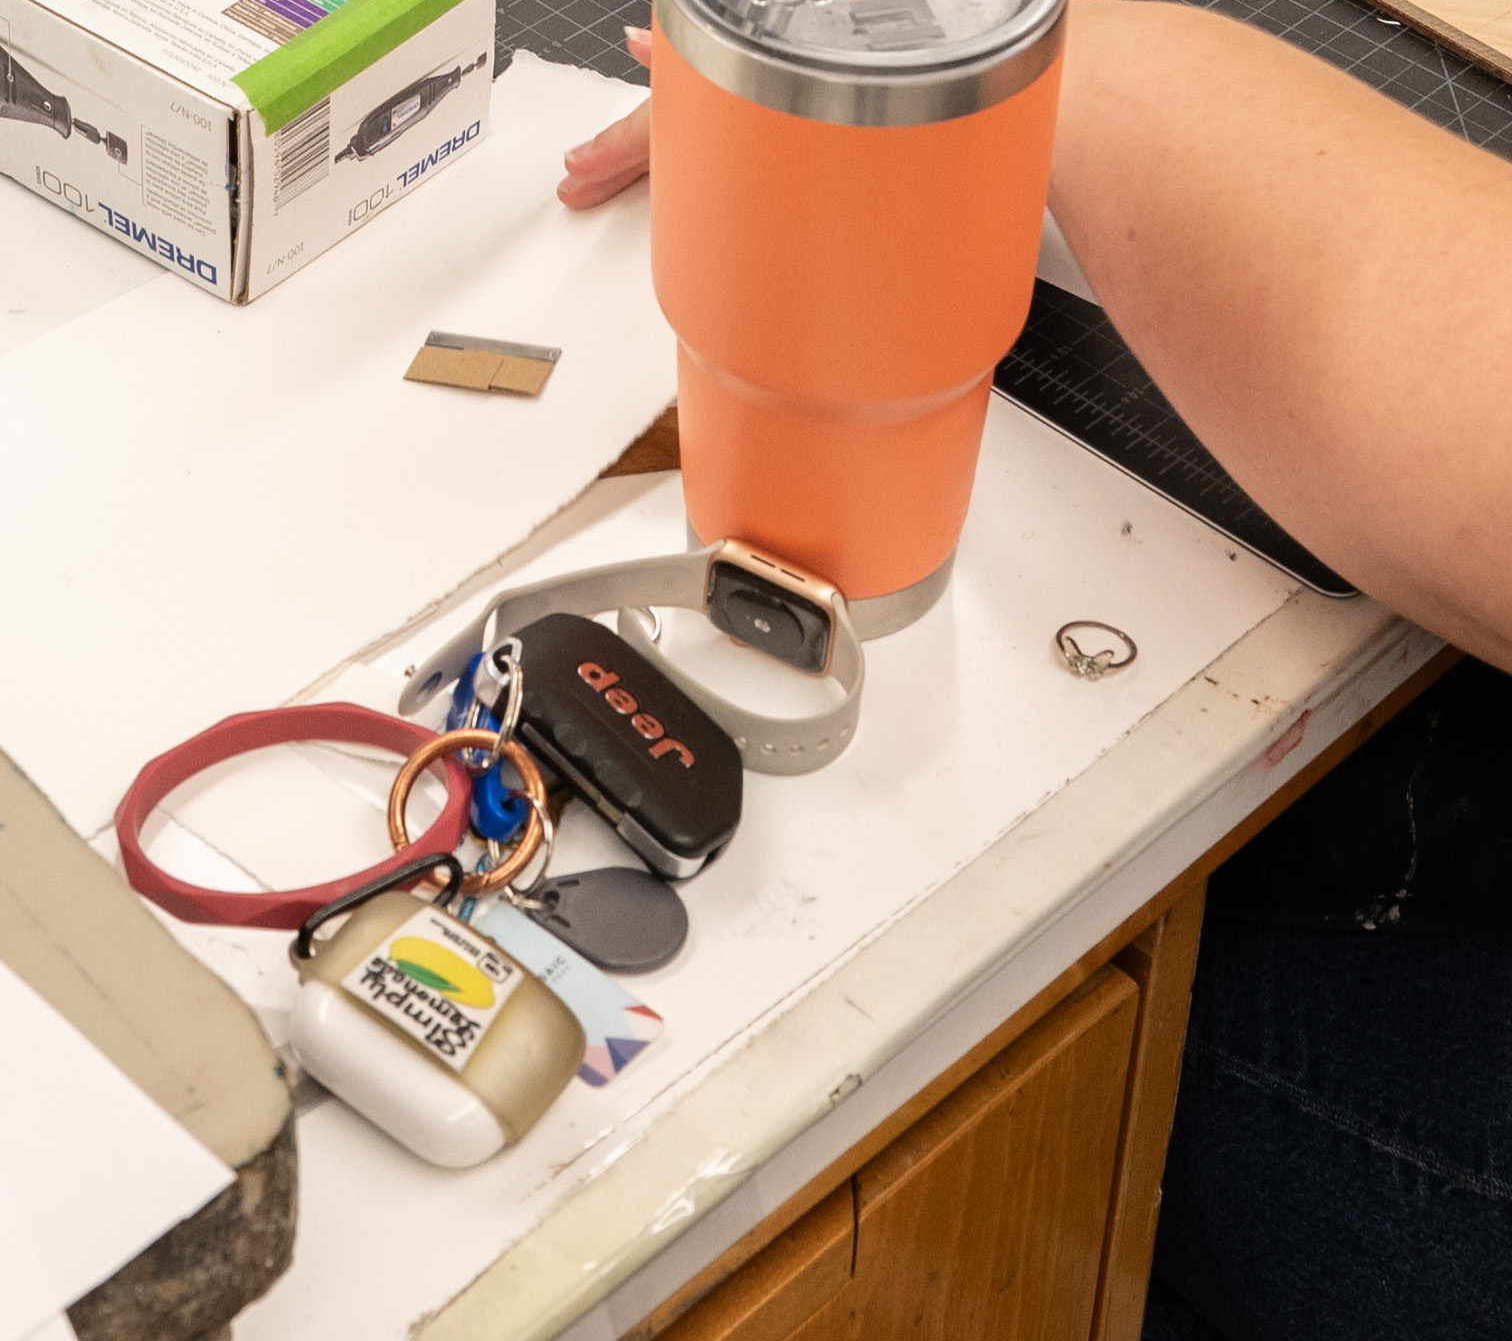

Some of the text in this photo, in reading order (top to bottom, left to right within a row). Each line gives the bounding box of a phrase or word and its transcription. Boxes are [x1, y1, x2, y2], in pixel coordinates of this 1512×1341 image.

[43, 169, 96, 214] 100
[354, 120, 481, 225] DREMEL 100
[98, 200, 218, 287] DREMEL
[576, 661, 697, 772] Jeep
[360, 968, 467, 1057] Simply
